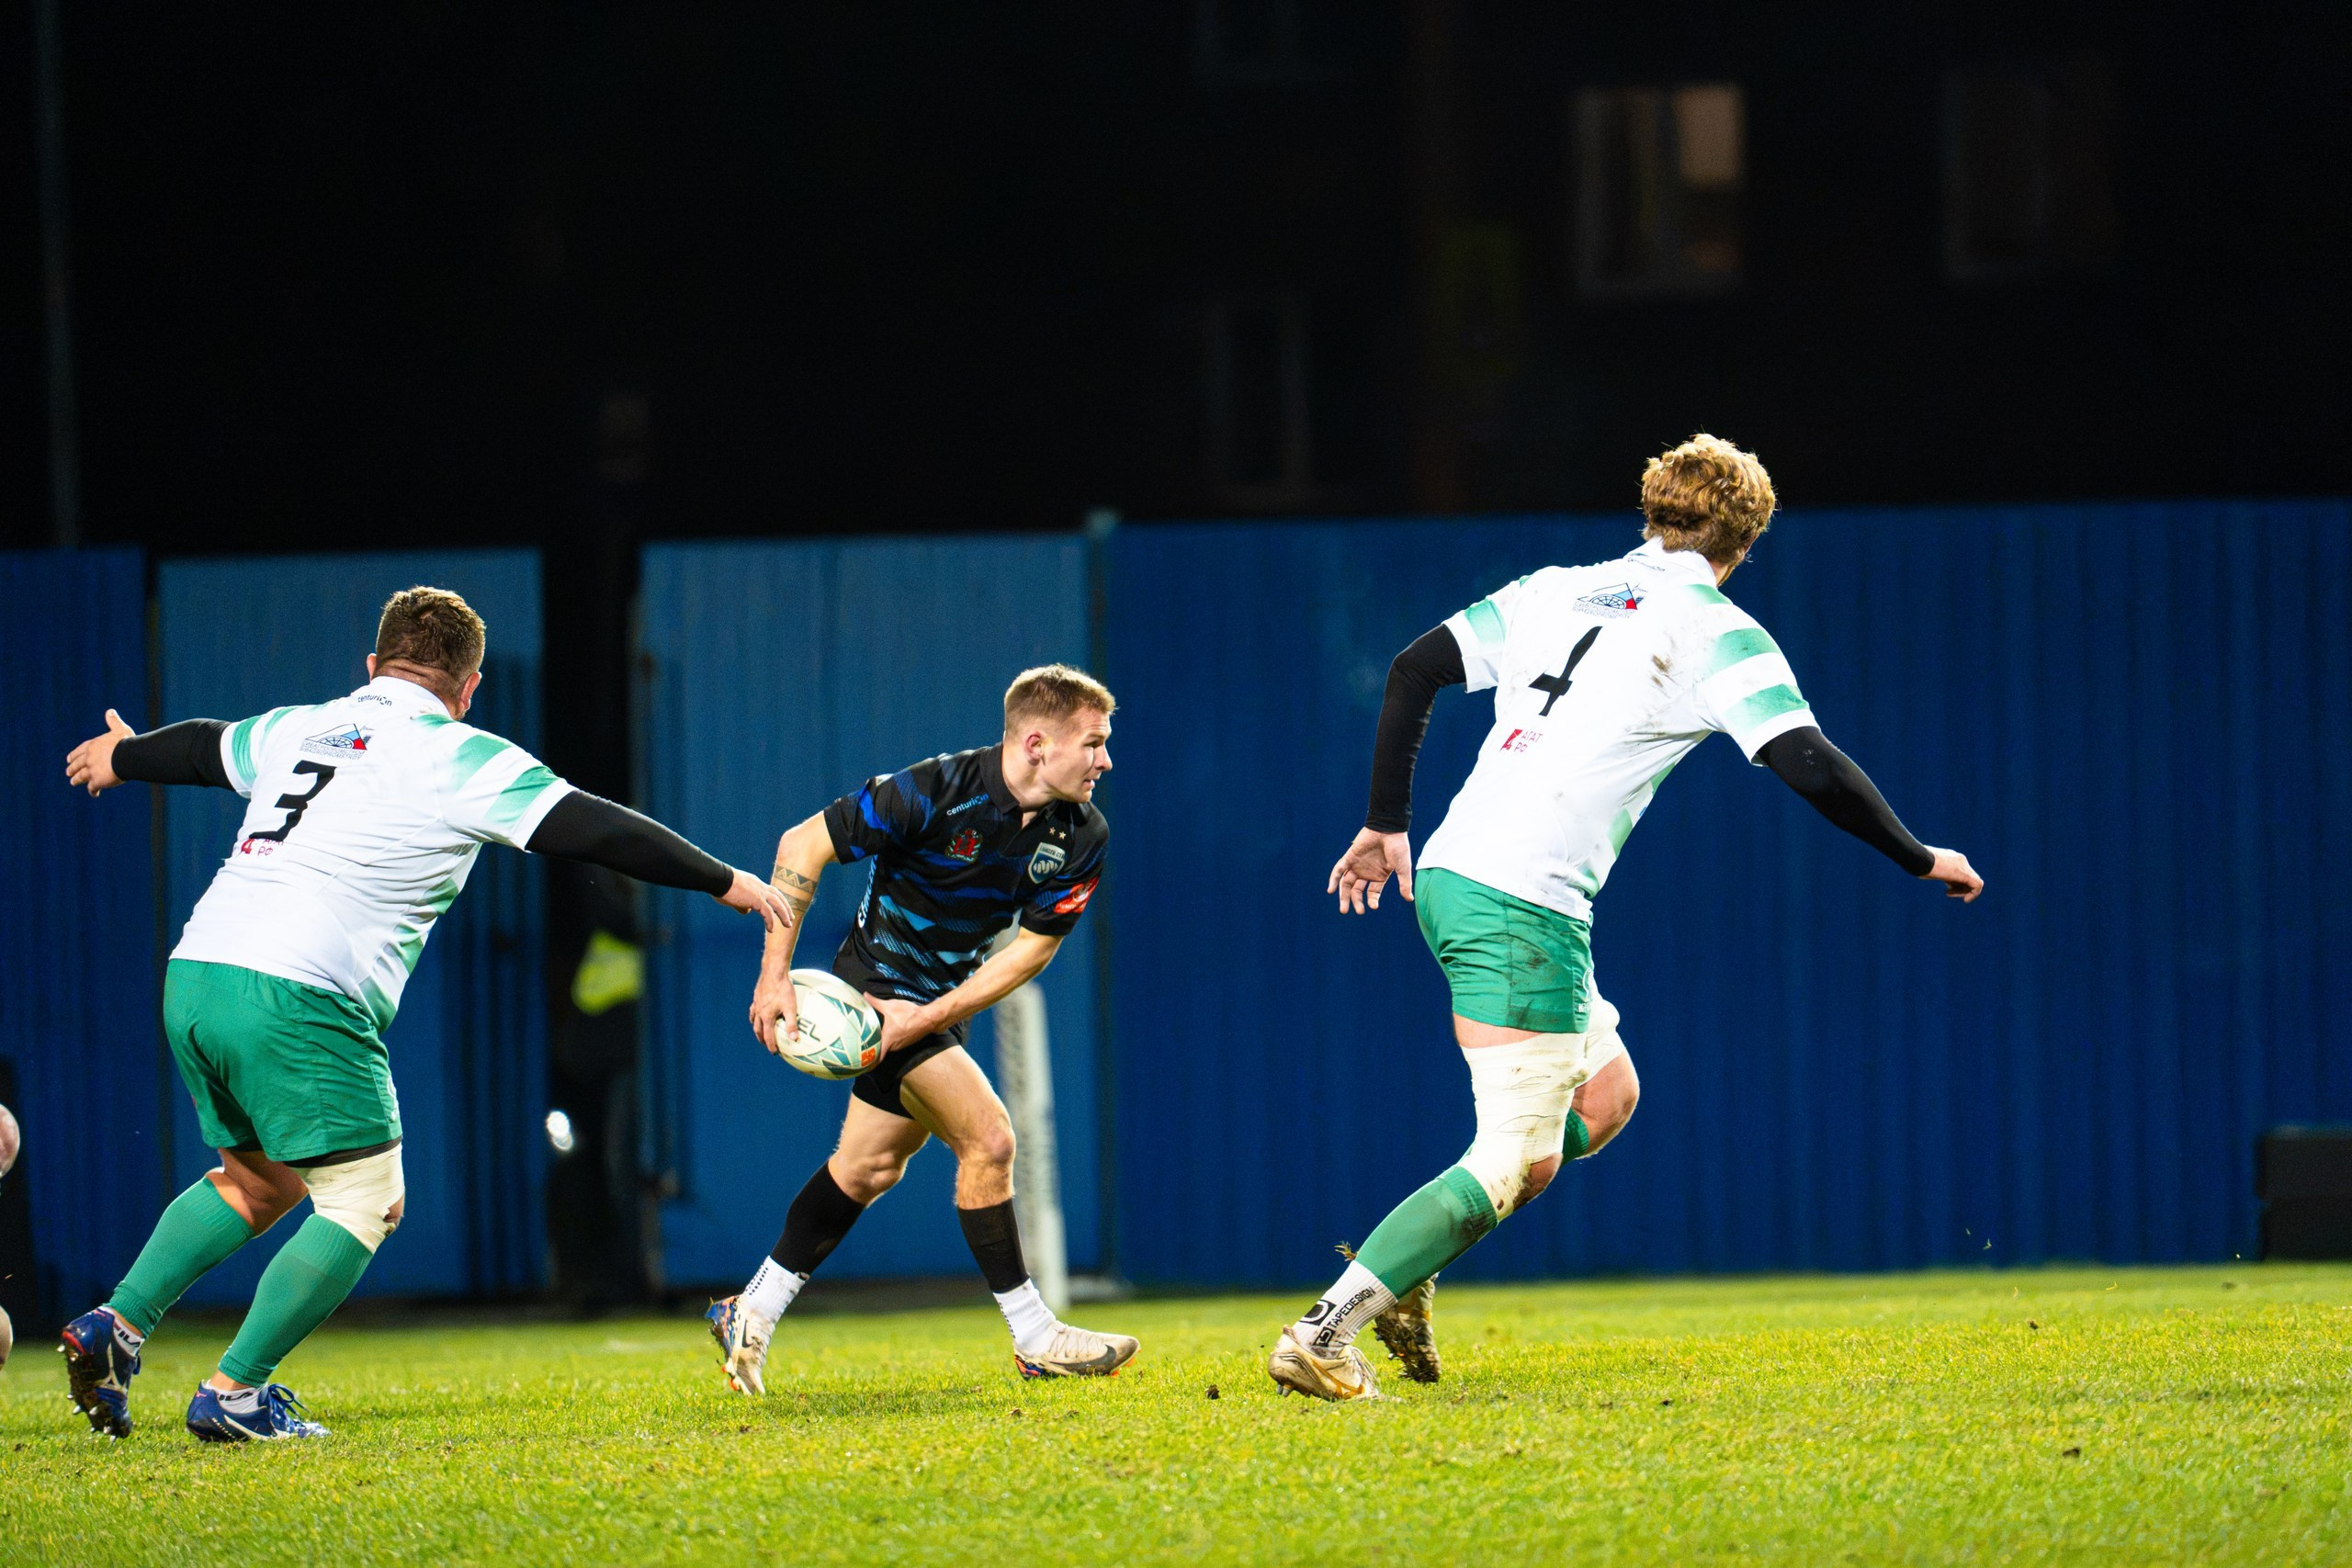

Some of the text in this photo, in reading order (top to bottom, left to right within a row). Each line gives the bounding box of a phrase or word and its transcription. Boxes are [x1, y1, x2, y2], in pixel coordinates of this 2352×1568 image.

[1529, 626, 1602, 716] 4
[249, 760, 336, 841] 3
[946, 794, 989, 816] centurion
[797, 1017, 821, 1042] EL
[1327, 1286, 1376, 1328] TAPEDESIGN
